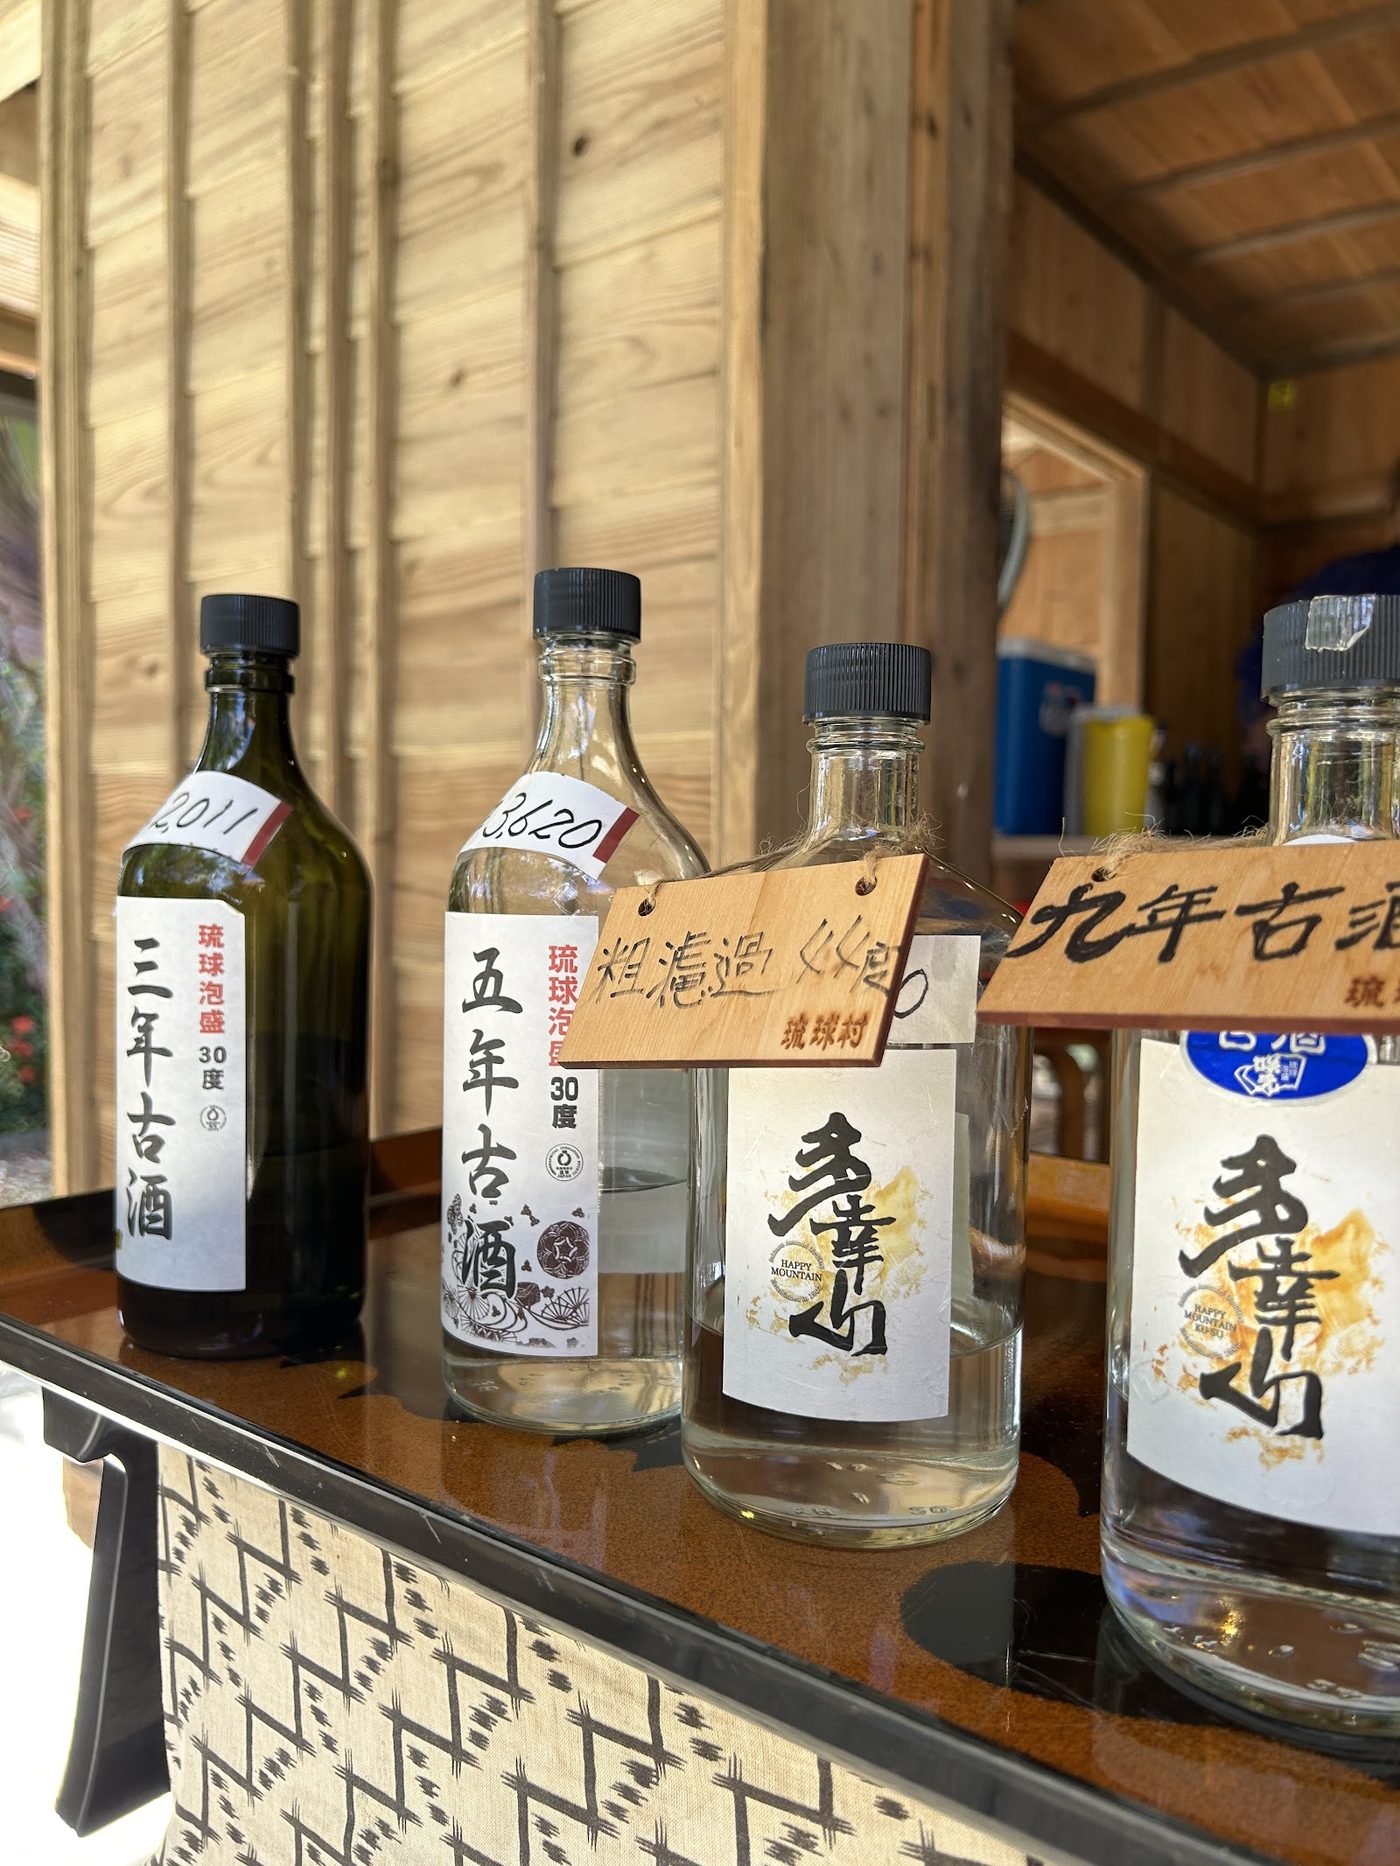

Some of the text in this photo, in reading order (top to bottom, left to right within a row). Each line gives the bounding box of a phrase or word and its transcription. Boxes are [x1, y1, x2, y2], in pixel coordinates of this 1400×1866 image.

[482, 792, 603, 848] 3,620
[198, 923, 225, 1034] 琉球泡盛
[780, 1010, 869, 1051] 琉球村
[126, 938, 177, 1241] 三年古酒
[461, 947, 524, 1299] 五年古酒
[770, 1267, 823, 1281] MOUNTAIN
[781, 1259, 812, 1271] HAPPY
[1180, 1310, 1237, 1331] MOUNTAIN
[1195, 1304, 1226, 1319] HAPPY
